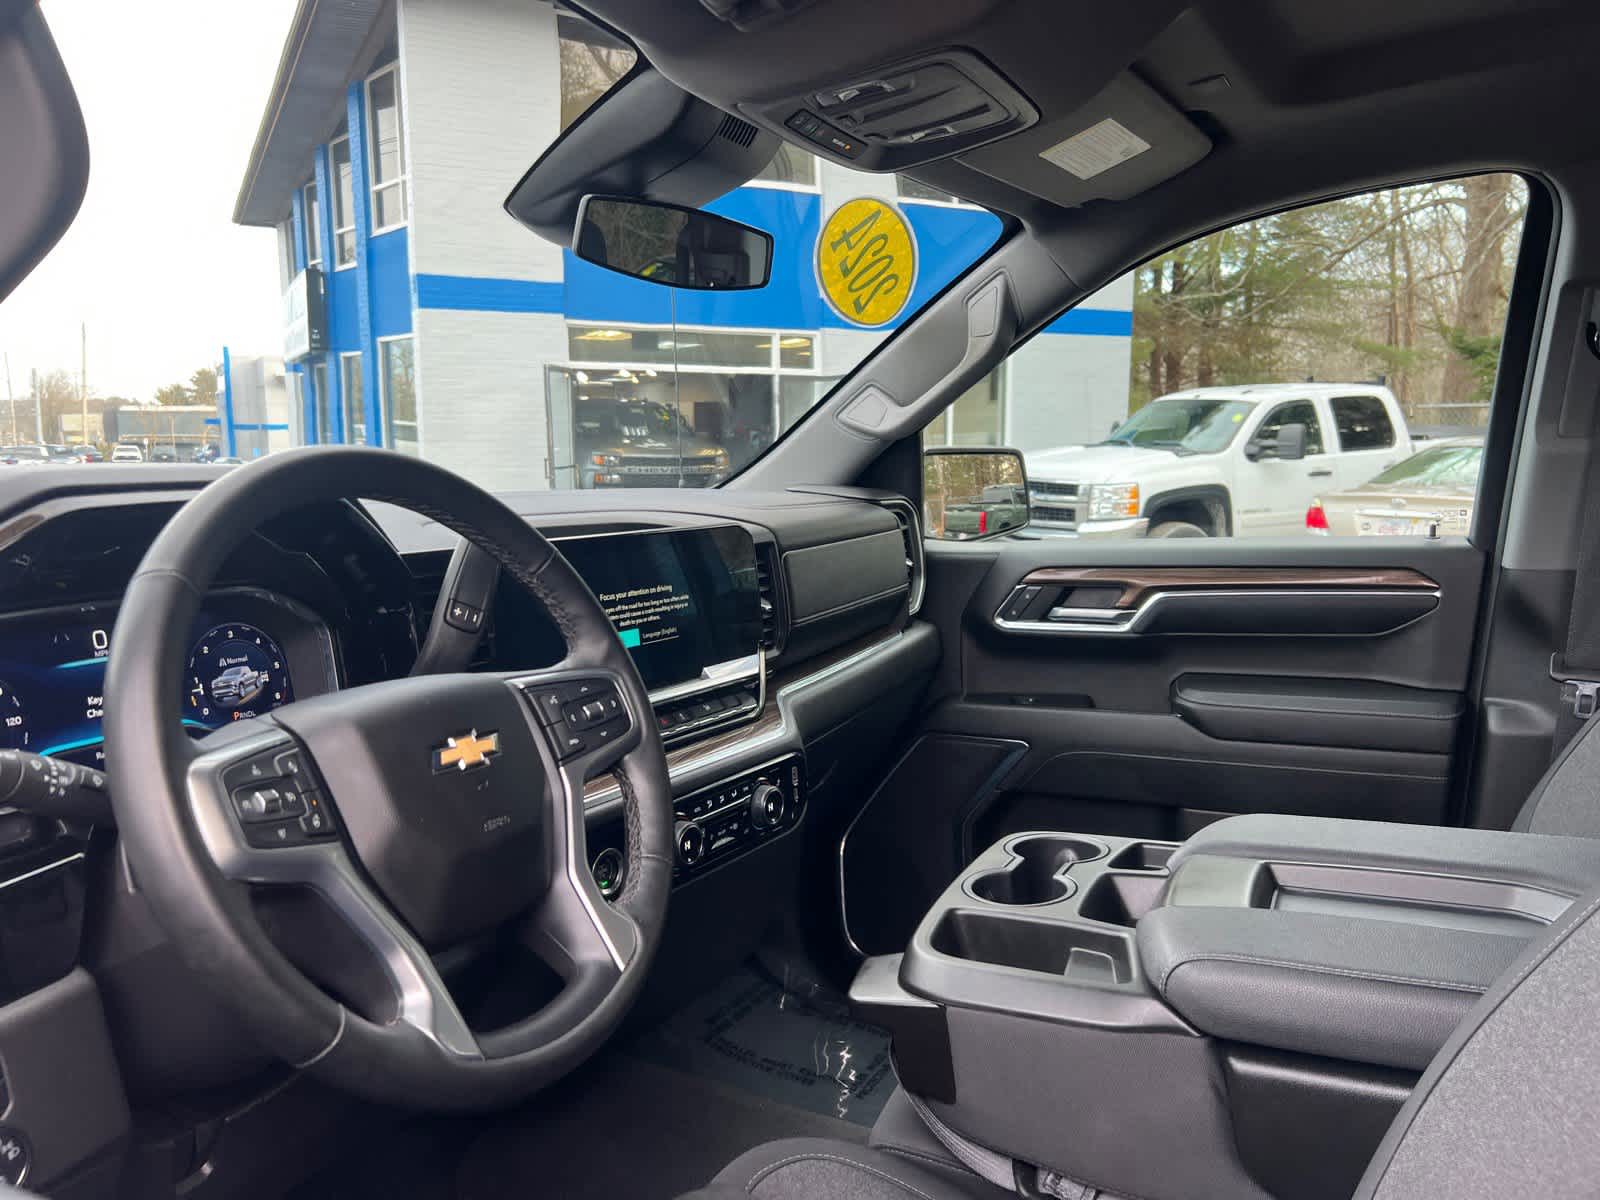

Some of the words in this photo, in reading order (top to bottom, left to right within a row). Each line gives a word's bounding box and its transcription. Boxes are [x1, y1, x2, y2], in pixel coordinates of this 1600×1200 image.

[616, 592, 627, 600] your
[628, 589, 649, 597] attention
[92, 629, 109, 649] 0
[227, 630, 233, 639] 3
[202, 646, 209, 654] 2
[5, 716, 22, 727] 120
